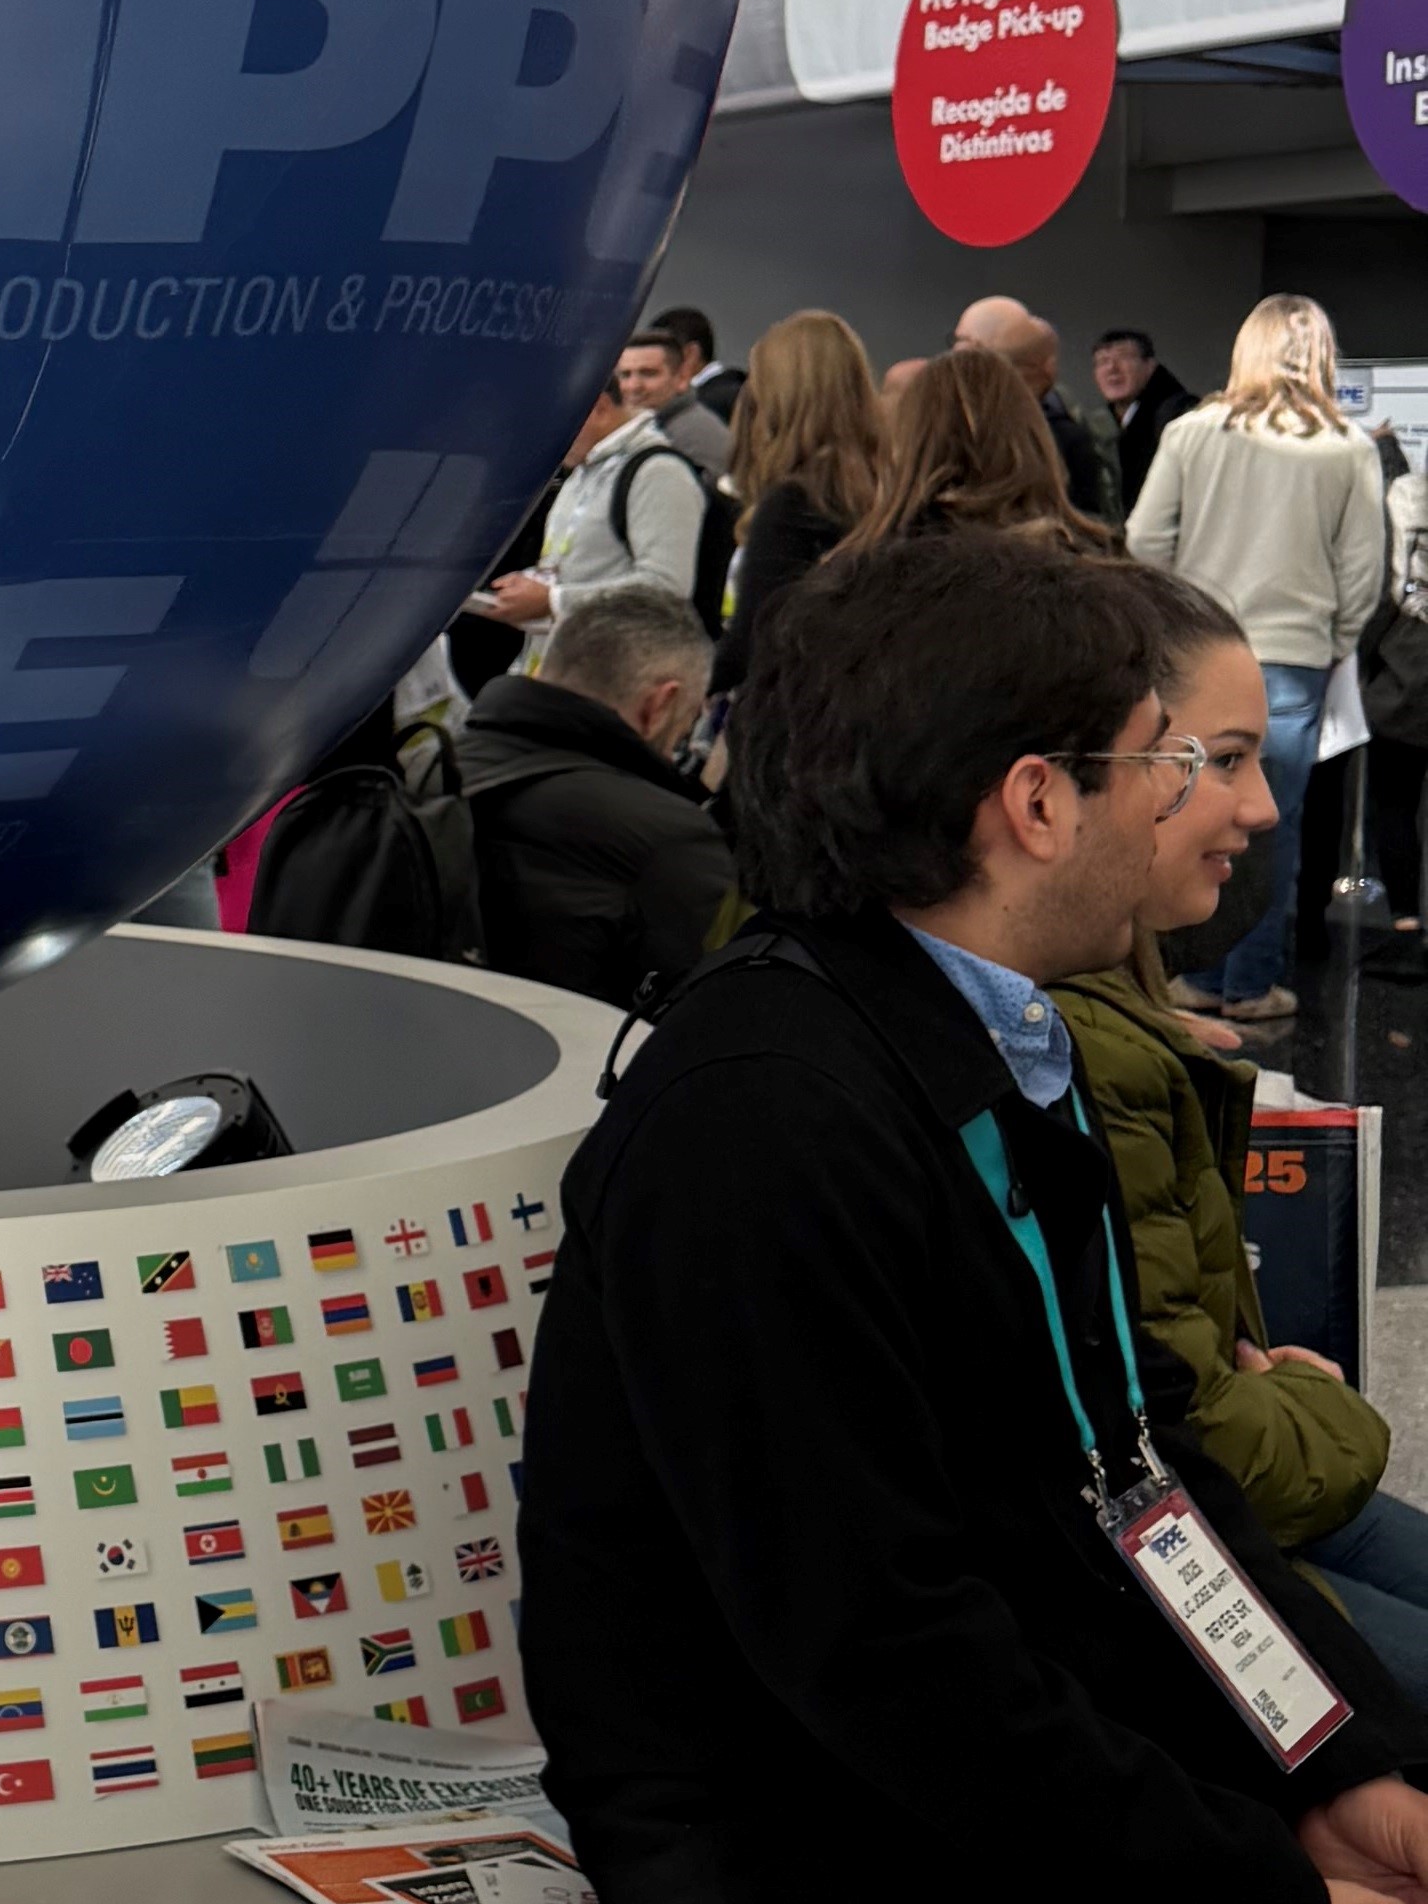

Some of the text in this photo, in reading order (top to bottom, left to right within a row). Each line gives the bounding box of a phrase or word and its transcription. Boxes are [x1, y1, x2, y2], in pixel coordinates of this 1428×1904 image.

[924, 4, 1084, 52] Badge Pick-up
[932, 78, 1067, 127] Recogida de
[940, 126, 1053, 164] Distintivos
[326, 272, 369, 337] &
[290, 1763, 331, 1794] 40+
[333, 1769, 401, 1801] YEARS
[400, 1779, 428, 1800] OF
